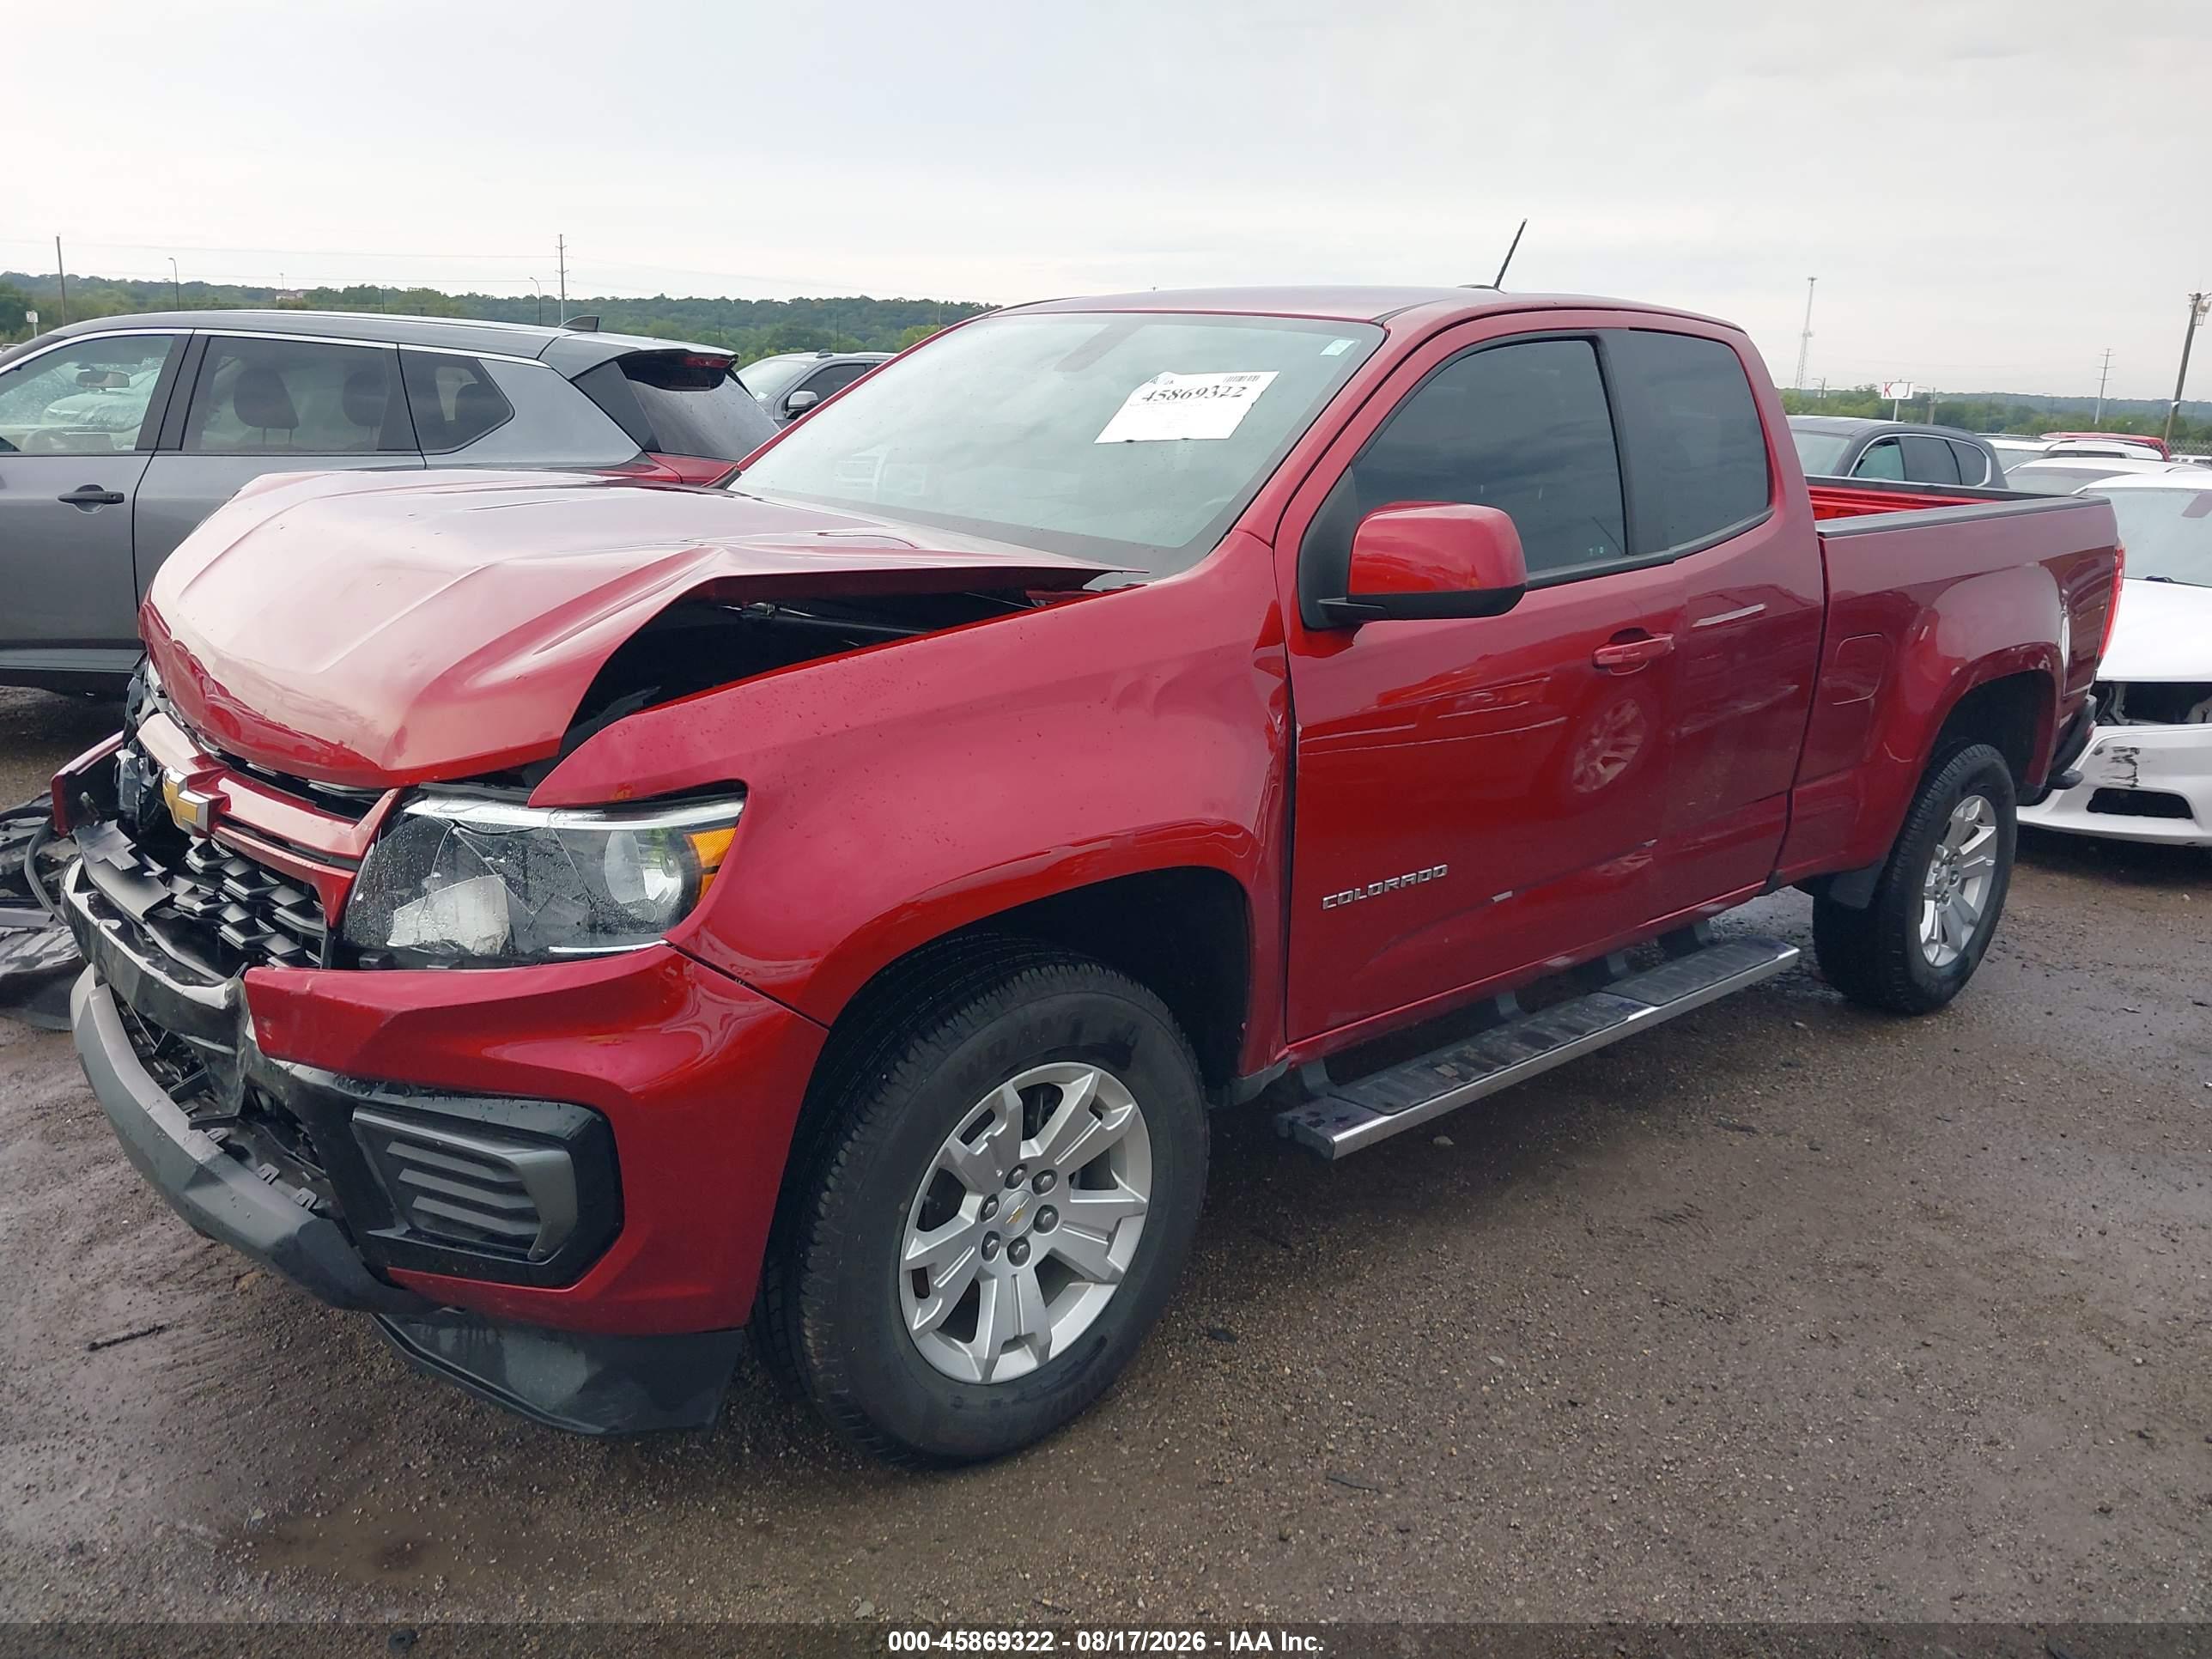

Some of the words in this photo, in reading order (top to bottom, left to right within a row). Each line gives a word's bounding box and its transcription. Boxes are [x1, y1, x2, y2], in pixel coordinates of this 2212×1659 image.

[1141, 385, 1248, 402] 45869322
[1883, 382, 1893, 398] K
[1903, 382, 1911, 398] J
[1322, 864, 1449, 910] COLORADO
